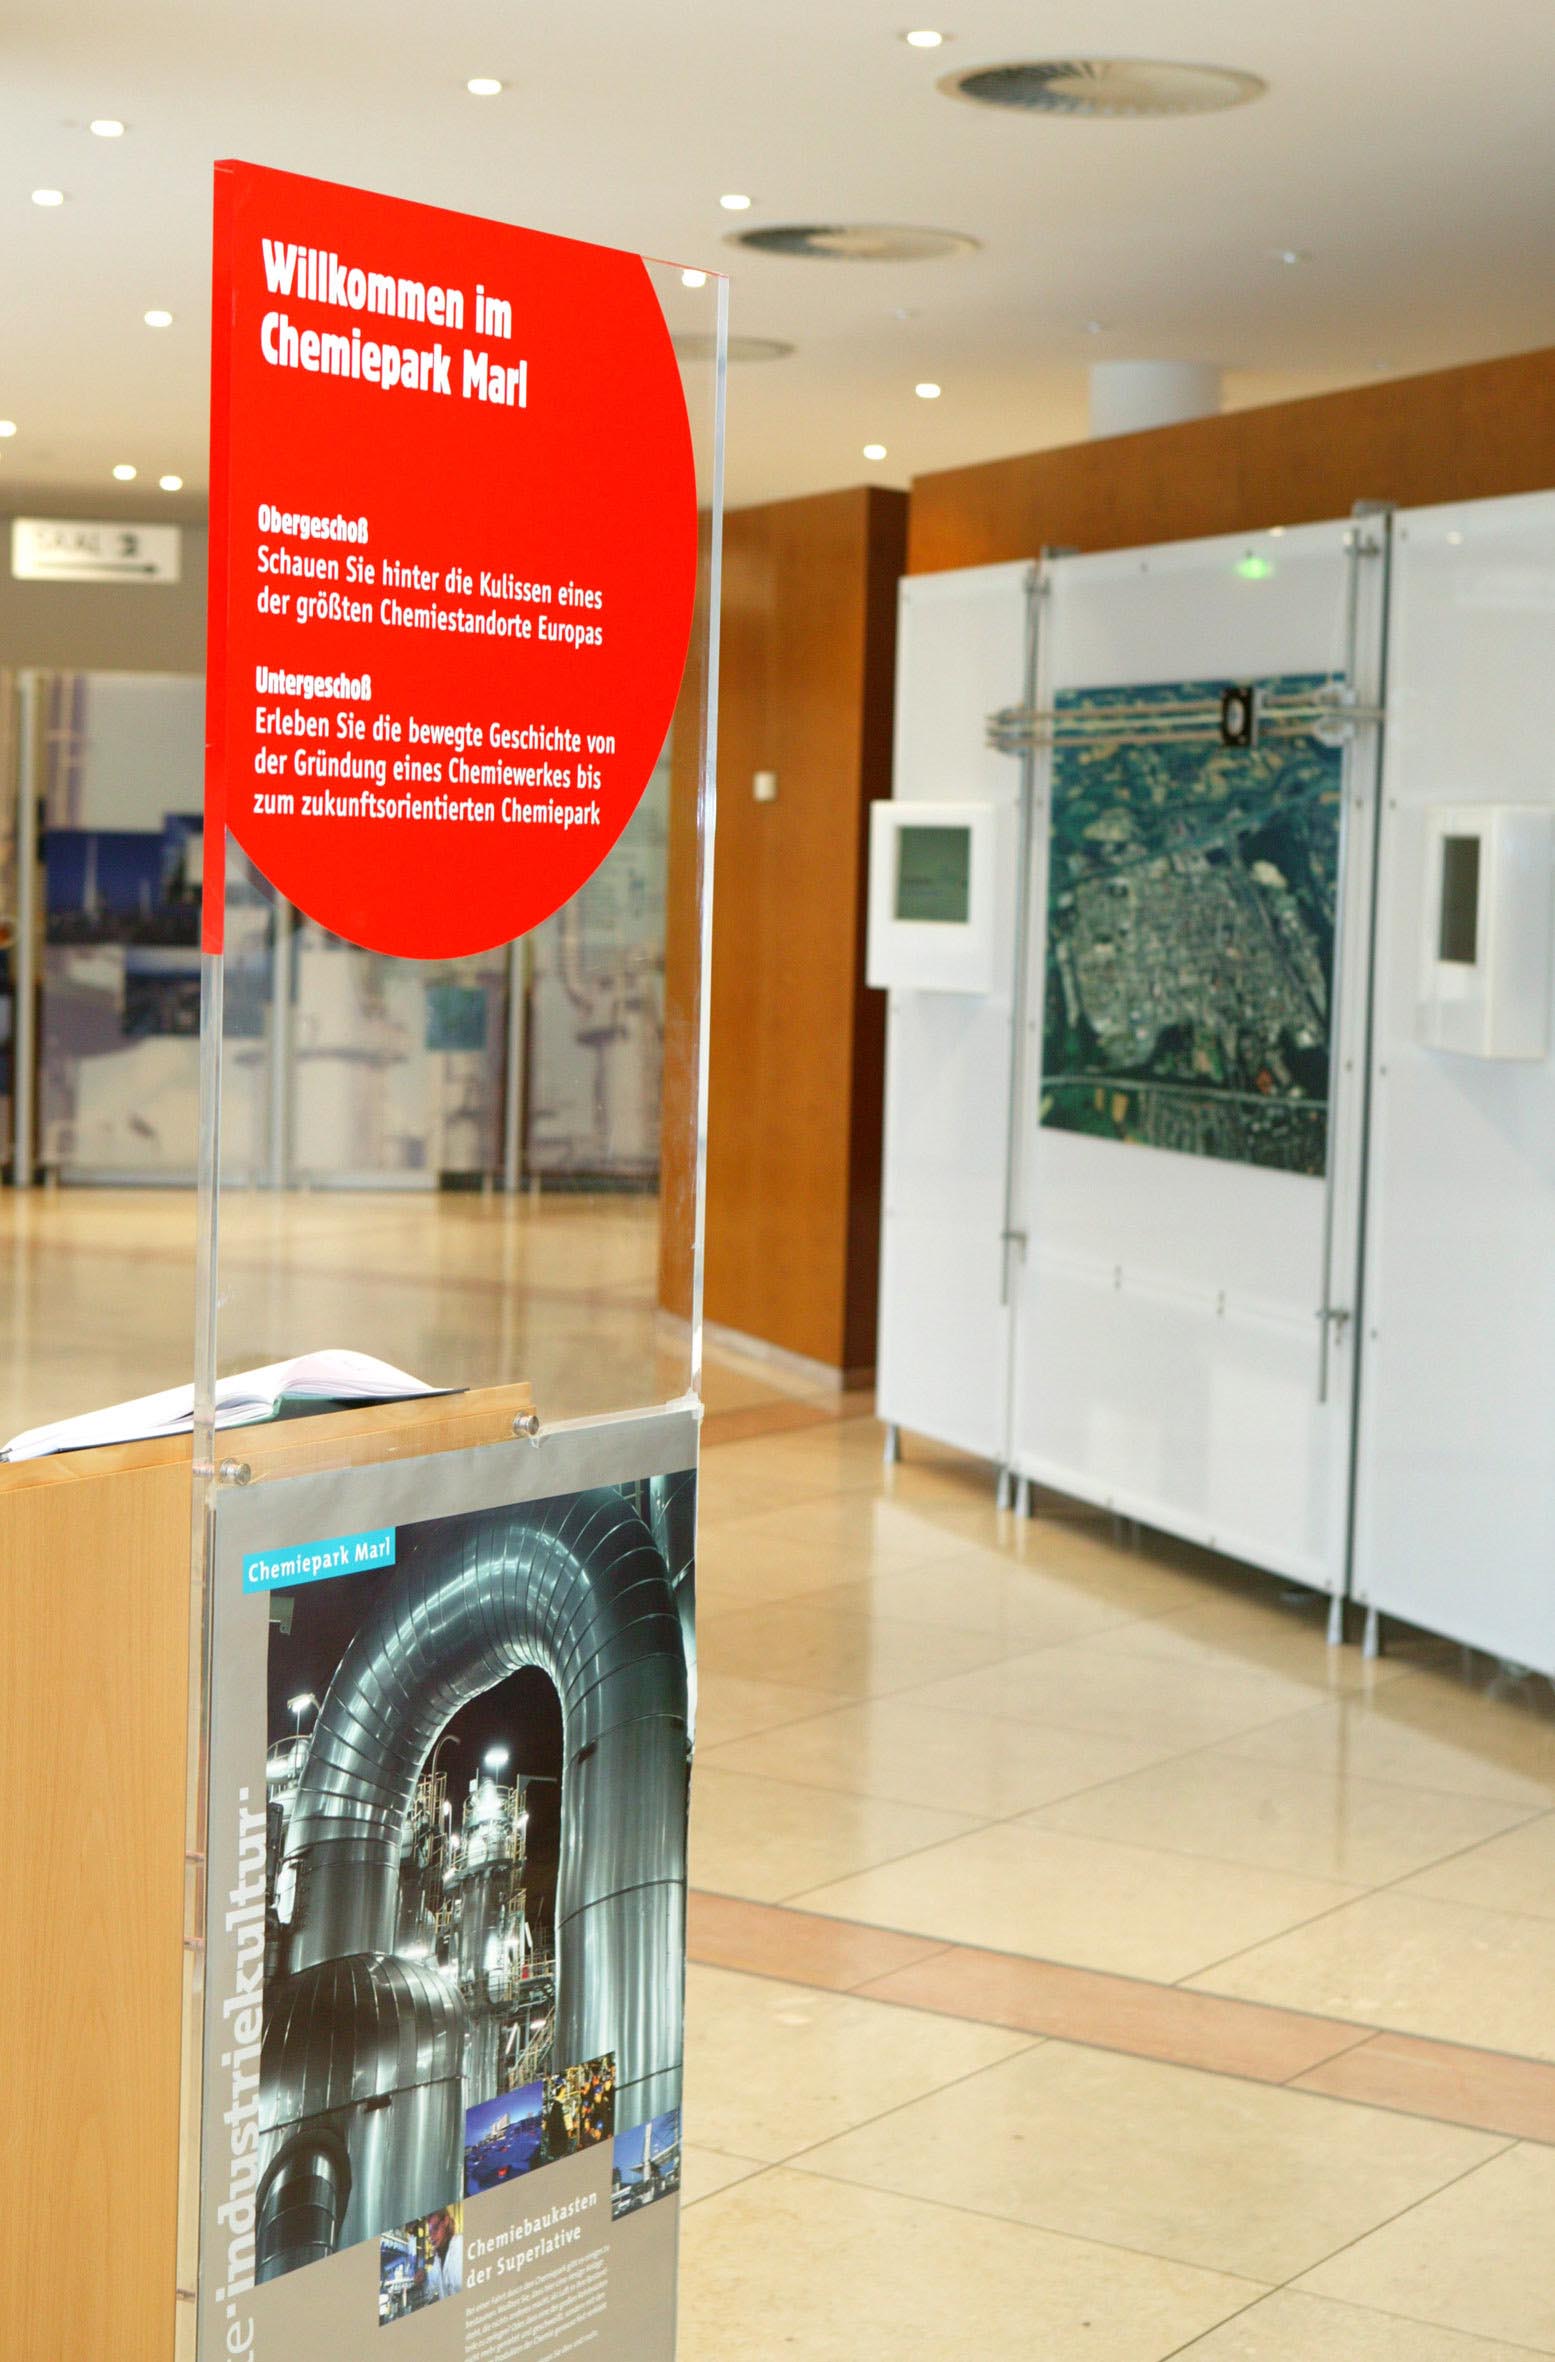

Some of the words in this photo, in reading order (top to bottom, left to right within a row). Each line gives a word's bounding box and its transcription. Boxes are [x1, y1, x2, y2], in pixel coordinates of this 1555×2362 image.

[262, 238, 464, 329] Willkommen
[475, 285, 512, 339] im
[261, 311, 452, 396] Chemiepark
[462, 349, 528, 409] Marl
[257, 504, 369, 544] Obergeschoß
[257, 545, 339, 580] Schauen
[346, 556, 376, 584] Sie
[382, 559, 440, 591] hinter
[445, 567, 473, 596] die
[480, 571, 552, 603] Kulissen
[558, 581, 603, 609] eines
[257, 586, 291, 614] der
[296, 590, 373, 624] größten
[380, 599, 532, 638] Chemiestandorte
[538, 615, 603, 649] Europas
[255, 666, 372, 700] Untergeschoß
[255, 707, 330, 738] Erleben
[336, 712, 366, 740] Sie
[372, 715, 402, 742] die
[408, 717, 483, 752] bewegte
[489, 722, 582, 752] Geschichte
[586, 735, 616, 754] von
[254, 746, 288, 775] der
[294, 749, 387, 786] Gründung
[393, 754, 442, 782] eines
[448, 758, 571, 789] Chemiewerkes
[577, 763, 602, 789] bis
[253, 793, 295, 814] zum
[301, 789, 495, 822] zukunftsorientierten
[501, 797, 601, 830] Chemiepark
[248, 1546, 349, 1582] Chemiepark
[355, 1537, 391, 1562] Marl
[467, 2192, 597, 2260] Chemiebaukasten
[466, 2266, 492, 2289] der
[496, 2225, 582, 2276] Superlative
